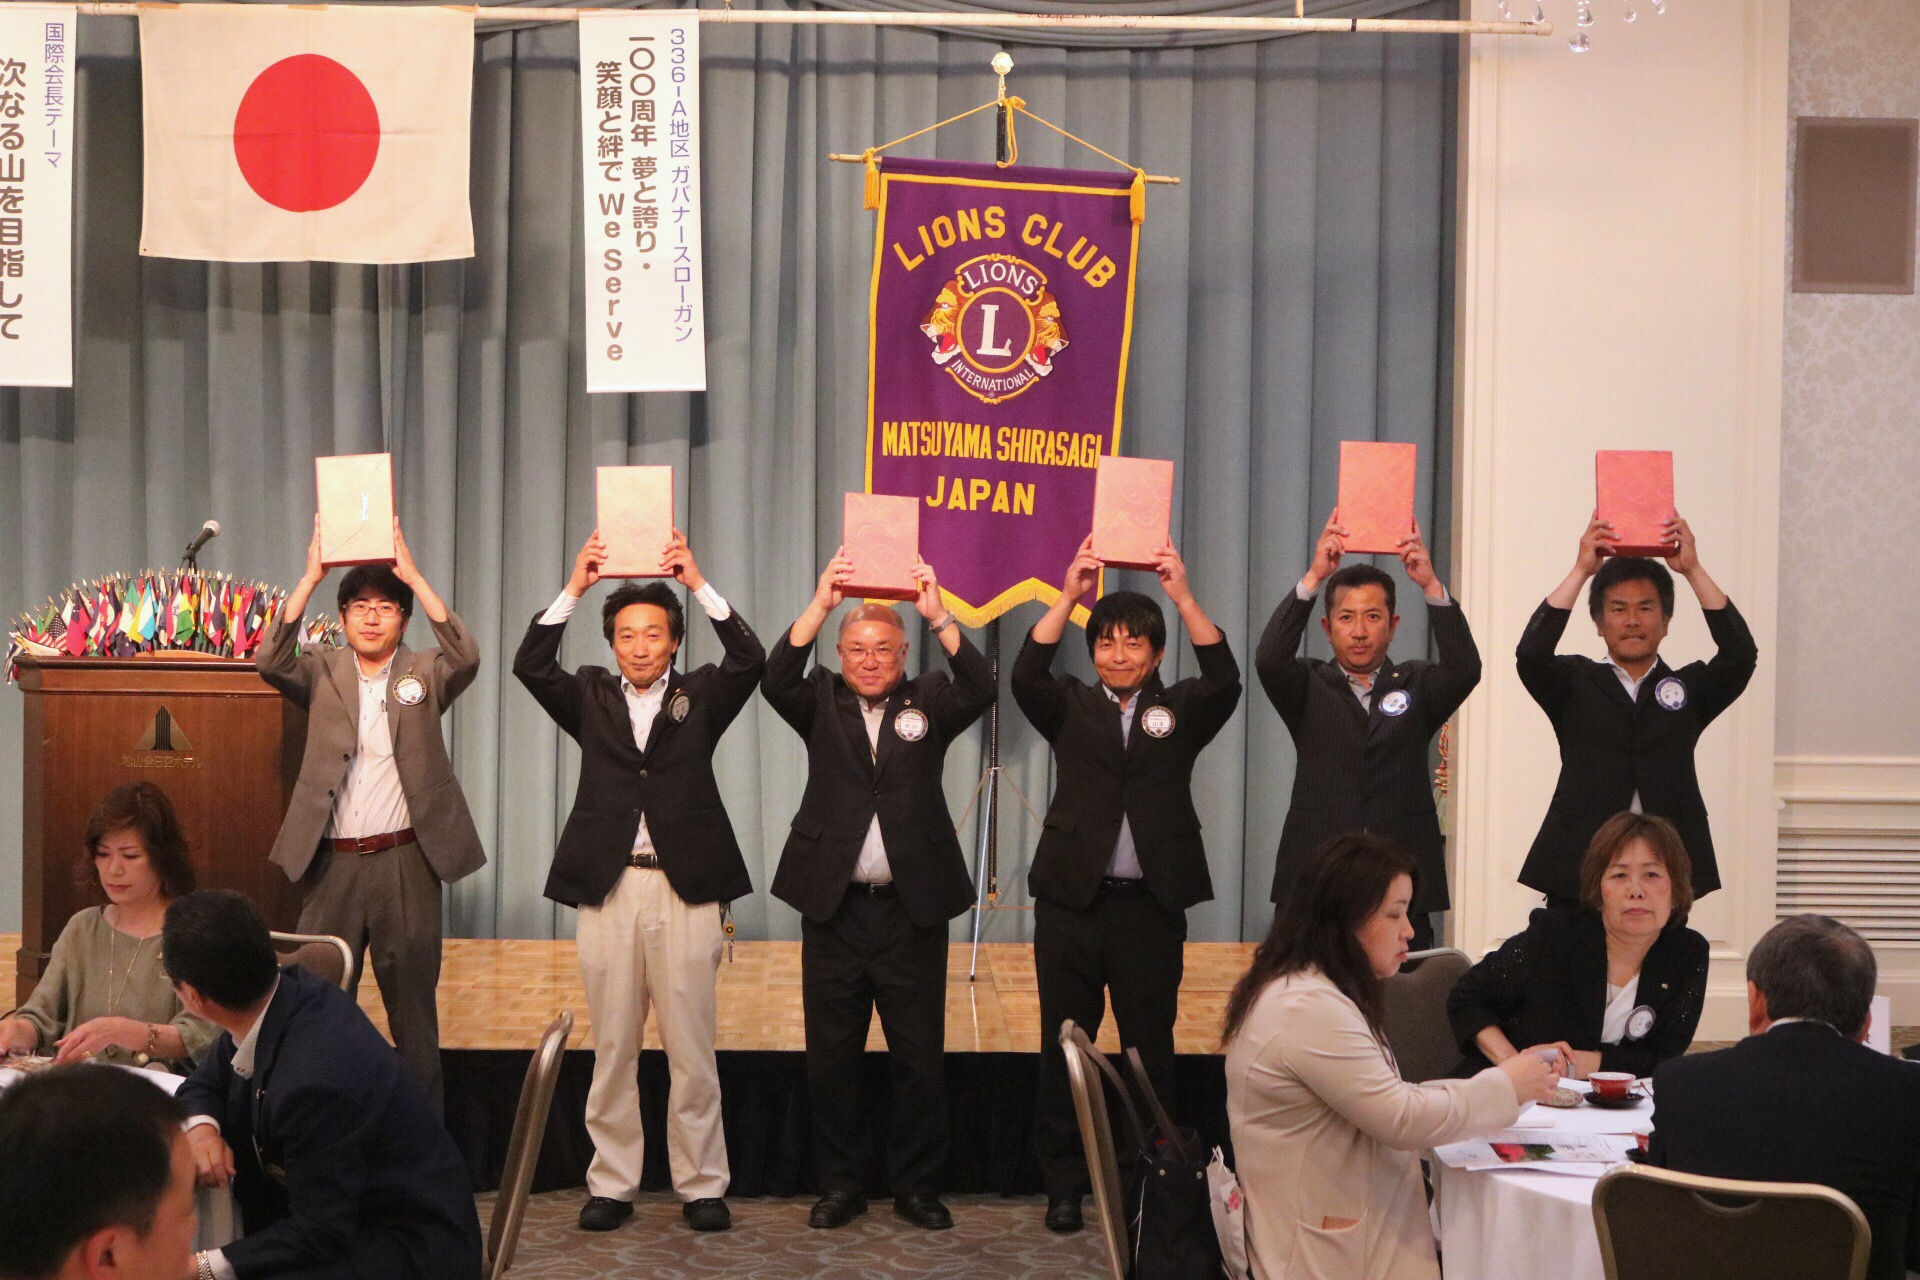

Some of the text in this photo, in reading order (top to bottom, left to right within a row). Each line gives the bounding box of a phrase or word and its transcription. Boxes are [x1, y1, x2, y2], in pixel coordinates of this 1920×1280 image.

[44, 22, 65, 169] 国際会長テーマ
[0, 57, 27, 340] 次なる山を目指して
[595, 61, 625, 362] 笑顔と絆で We Serve
[671, 165, 694, 343] ガバナースローガン
[893, 205, 1116, 288] LIONS CLUB
[963, 262, 1039, 295] LIONS
[976, 304, 1012, 357] L
[951, 359, 1035, 392] INTERNATIONAL
[882, 421, 1103, 469] MATSUYAMA SHIRASAGI
[925, 475, 1036, 516] JAPAN
